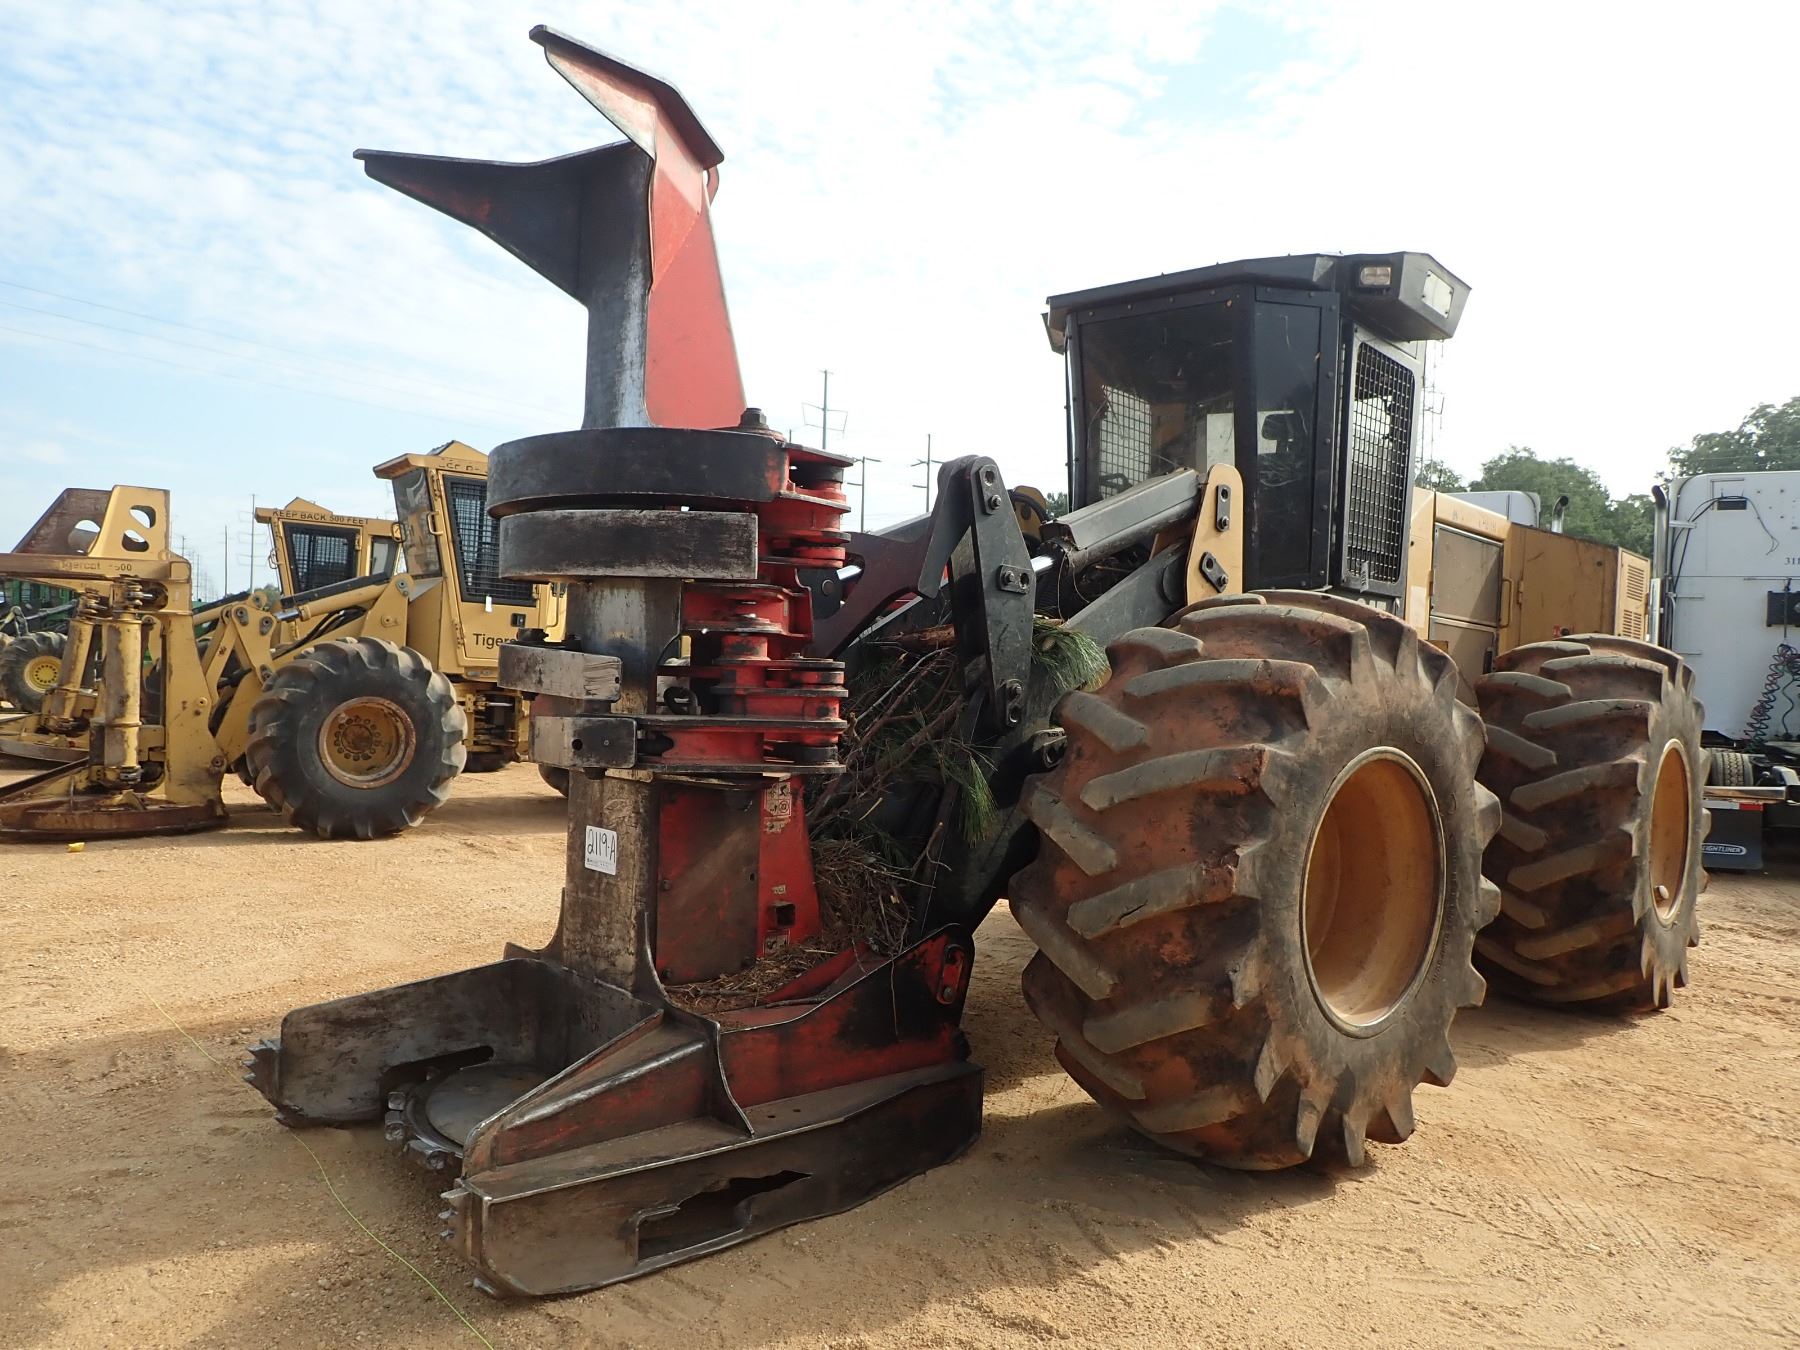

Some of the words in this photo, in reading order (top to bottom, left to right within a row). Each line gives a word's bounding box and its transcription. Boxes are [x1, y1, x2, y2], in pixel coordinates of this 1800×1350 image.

[272, 510, 297, 518] KEEP
[300, 512, 326, 521] BACK
[329, 515, 345, 523] 500
[346, 517, 369, 525] FEET
